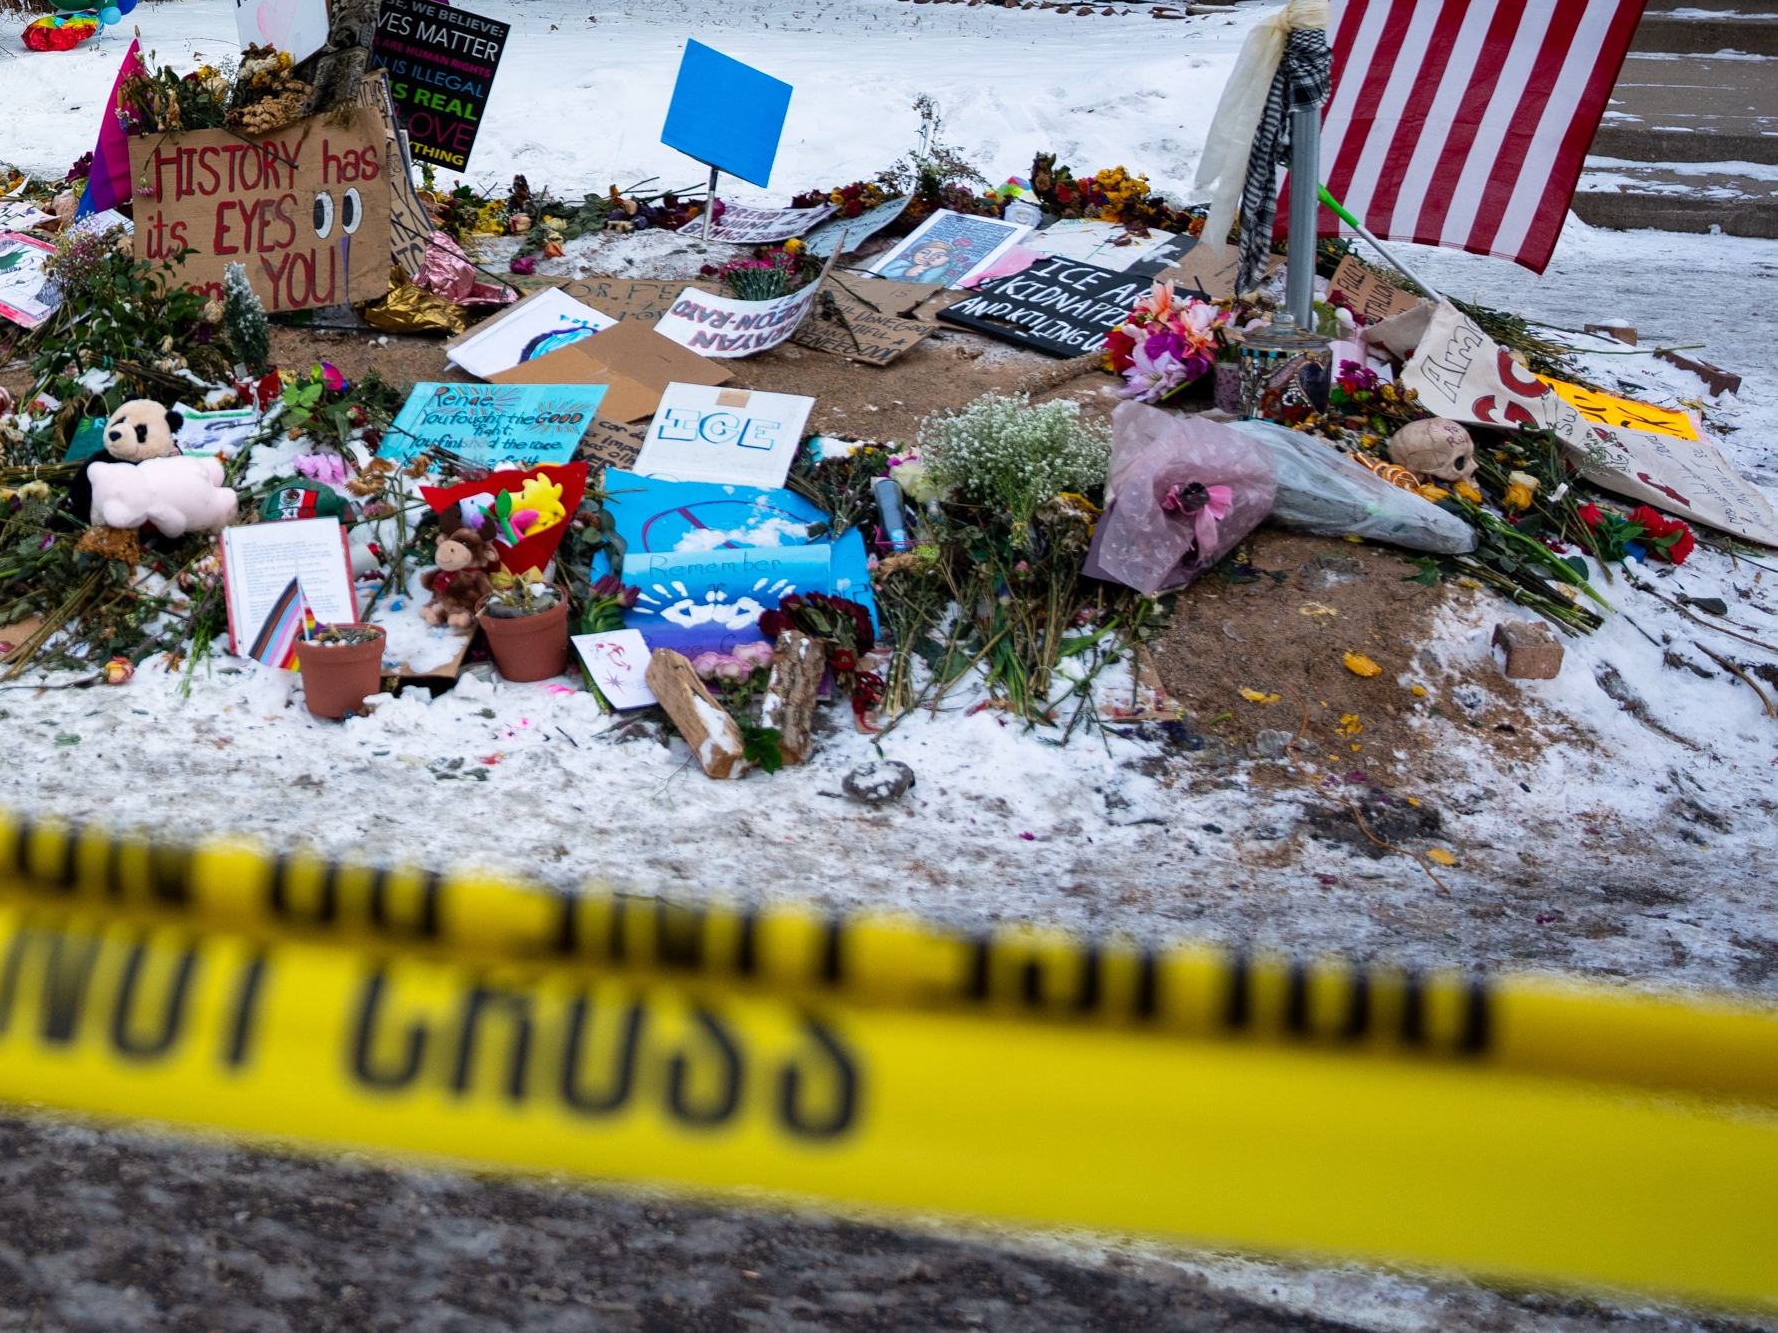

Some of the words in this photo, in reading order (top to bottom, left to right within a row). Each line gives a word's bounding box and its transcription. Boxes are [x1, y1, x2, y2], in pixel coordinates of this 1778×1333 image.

[376, 11, 413, 36] VES
[416, 21, 500, 62] MATTER
[412, 0, 435, 17] WE
[438, 9, 504, 38] BELIEVE:
[382, 39, 404, 53] ARE
[406, 45, 450, 66] HUMAN
[451, 59, 492, 79] RIGHTS
[392, 59, 407, 75] IS
[411, 64, 485, 99] ILLEGAL
[413, 88, 478, 121] REAL
[408, 112, 475, 151] OVE
[154, 139, 303, 203] HISTORY
[322, 138, 379, 184] has
[146, 210, 189, 260] its
[213, 193, 298, 256] EYES
[993, 275, 1129, 328] KIDNAPPI
[1029, 258, 1111, 291] ICE
[1096, 283, 1153, 308] AR
[949, 296, 1012, 317] AND
[1079, 331, 1109, 353] U
[508, 410, 535, 425] the
[535, 411, 584, 425] GOOD
[657, 408, 781, 451] ICE
[502, 440, 530, 450] the
[649, 551, 782, 577] Remember
[344, 966, 872, 1146] CROSS
